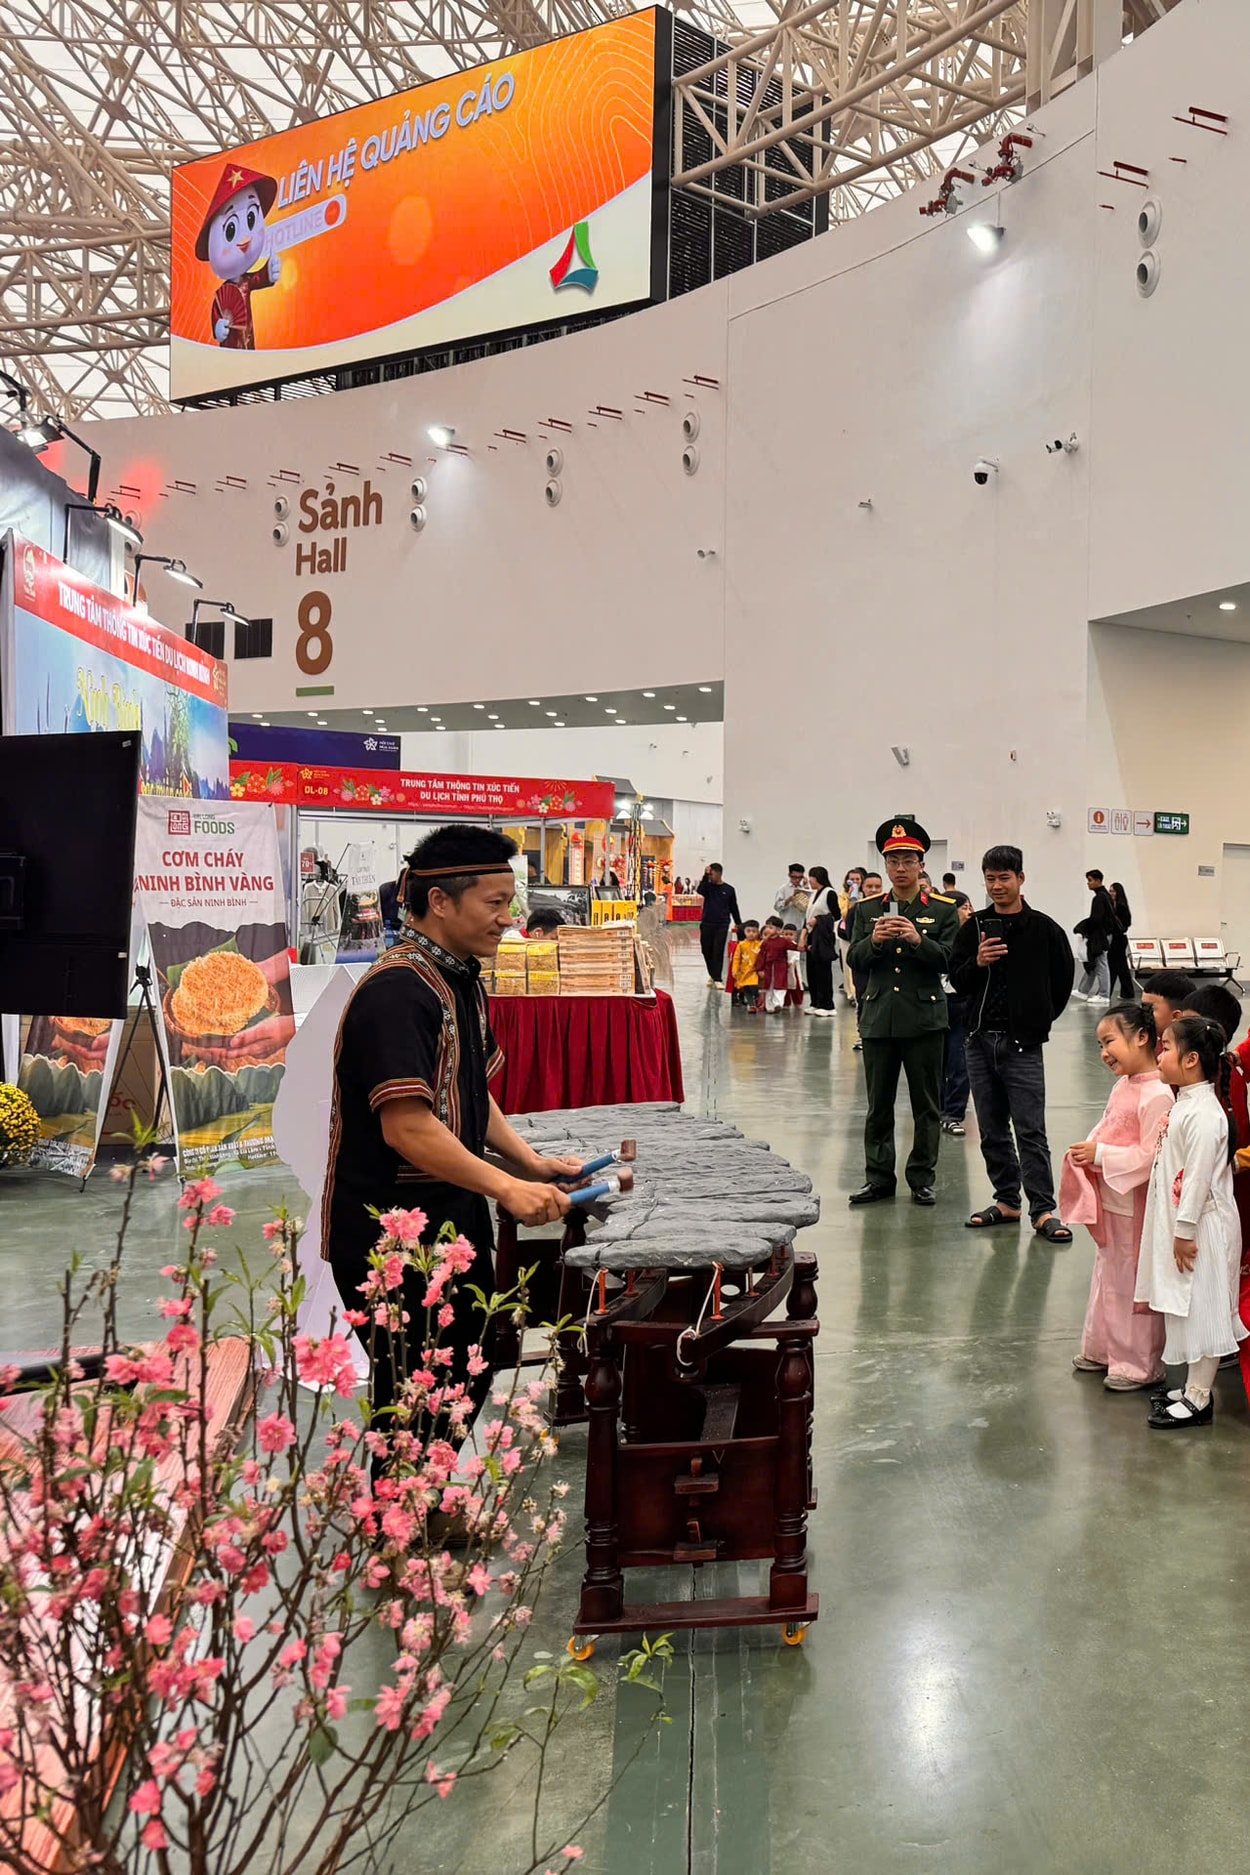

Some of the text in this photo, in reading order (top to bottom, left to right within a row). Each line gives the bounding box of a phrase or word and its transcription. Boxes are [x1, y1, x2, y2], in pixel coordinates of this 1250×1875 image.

[277, 73, 515, 209] LIÊN HỆ QUẢNG CÁO
[265, 211, 323, 248] HOTLINE
[298, 480, 383, 533] Sảnh
[296, 537, 347, 576] Hall
[58, 581, 86, 619] TRUNG
[86, 594, 102, 629] TÂM
[127, 622, 138, 649] TIN
[165, 644, 173, 667] DU
[296, 591, 333, 675] 8
[401, 778, 520, 793] TRUNG TÂM THÔNG TIN XÚC TIẾN
[420, 791, 503, 805] DU LỊCH TỈNH PHÚ THỌ
[194, 820, 235, 835] FOODS
[162, 848, 244, 868] CƠM CHÁY
[138, 872, 274, 891] NINH BÌNH VÀNG
[170, 898, 186, 908] ĐẶC
[188, 897, 204, 907] SẢN
[227, 897, 247, 907] BÌNH
